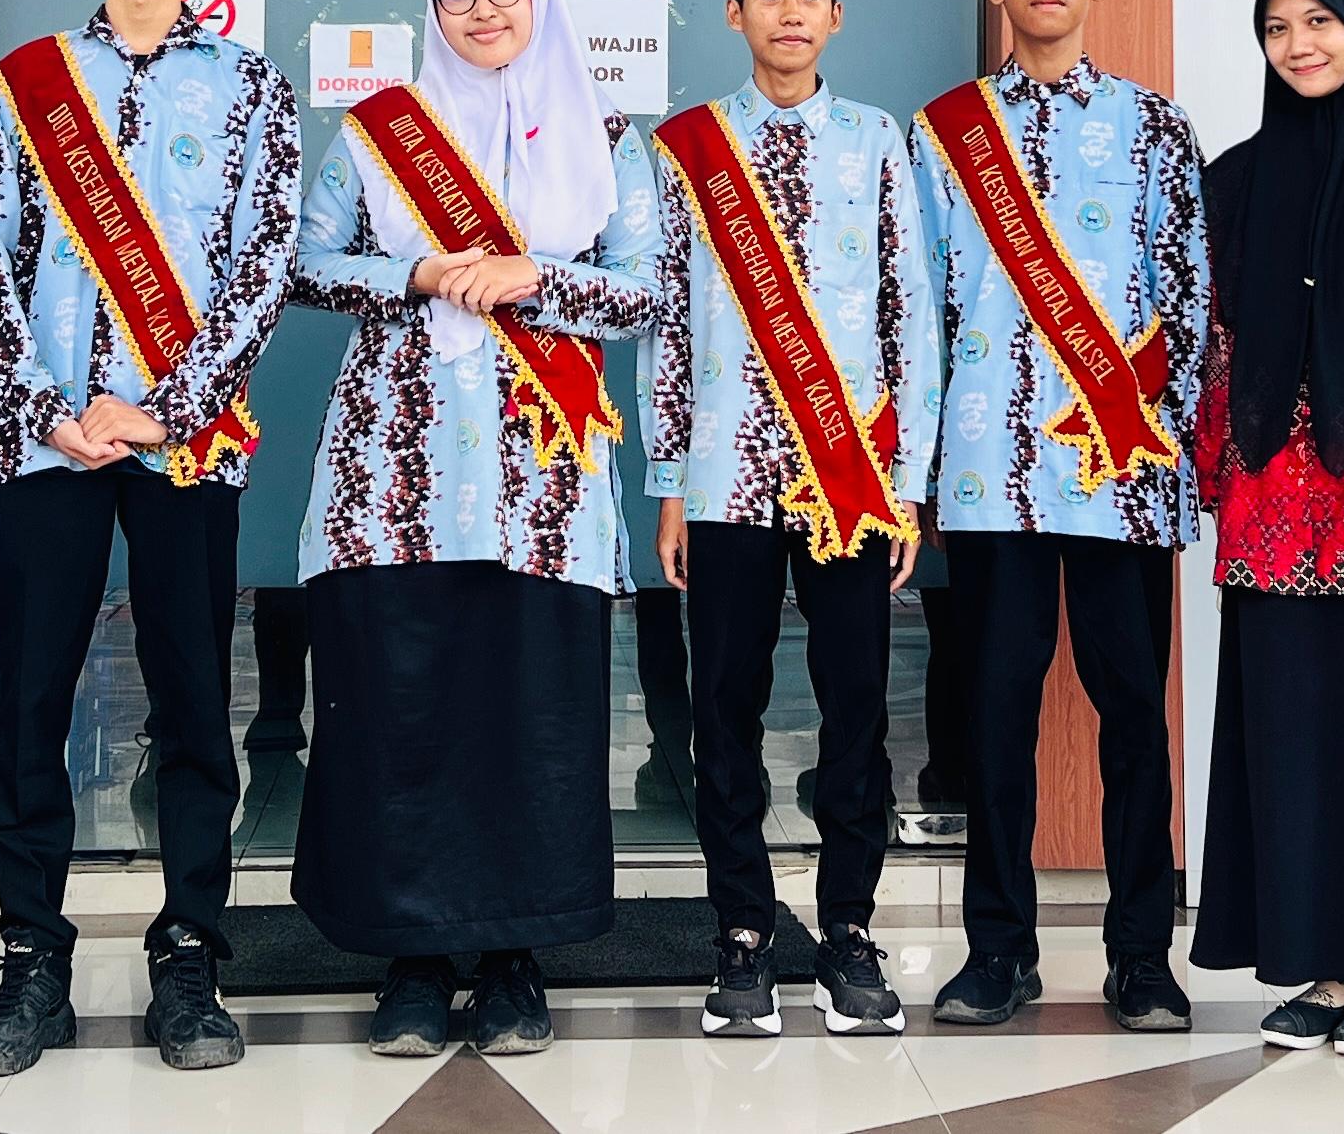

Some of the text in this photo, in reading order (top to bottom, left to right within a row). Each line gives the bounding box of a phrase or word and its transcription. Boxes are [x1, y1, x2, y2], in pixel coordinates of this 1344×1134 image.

[587, 36, 658, 53] WAJIB
[588, 66, 624, 82] OR
[46, 102, 188, 370] DUTA KESEHATAN MENTAL KALSE
[388, 113, 482, 236] DUTA KESEHATAN
[961, 124, 1115, 387] DUTA KESEHATAN MENTAL KALSEL
[706, 169, 847, 451] DUTA KESEHATAN MENTAL KALSEL
